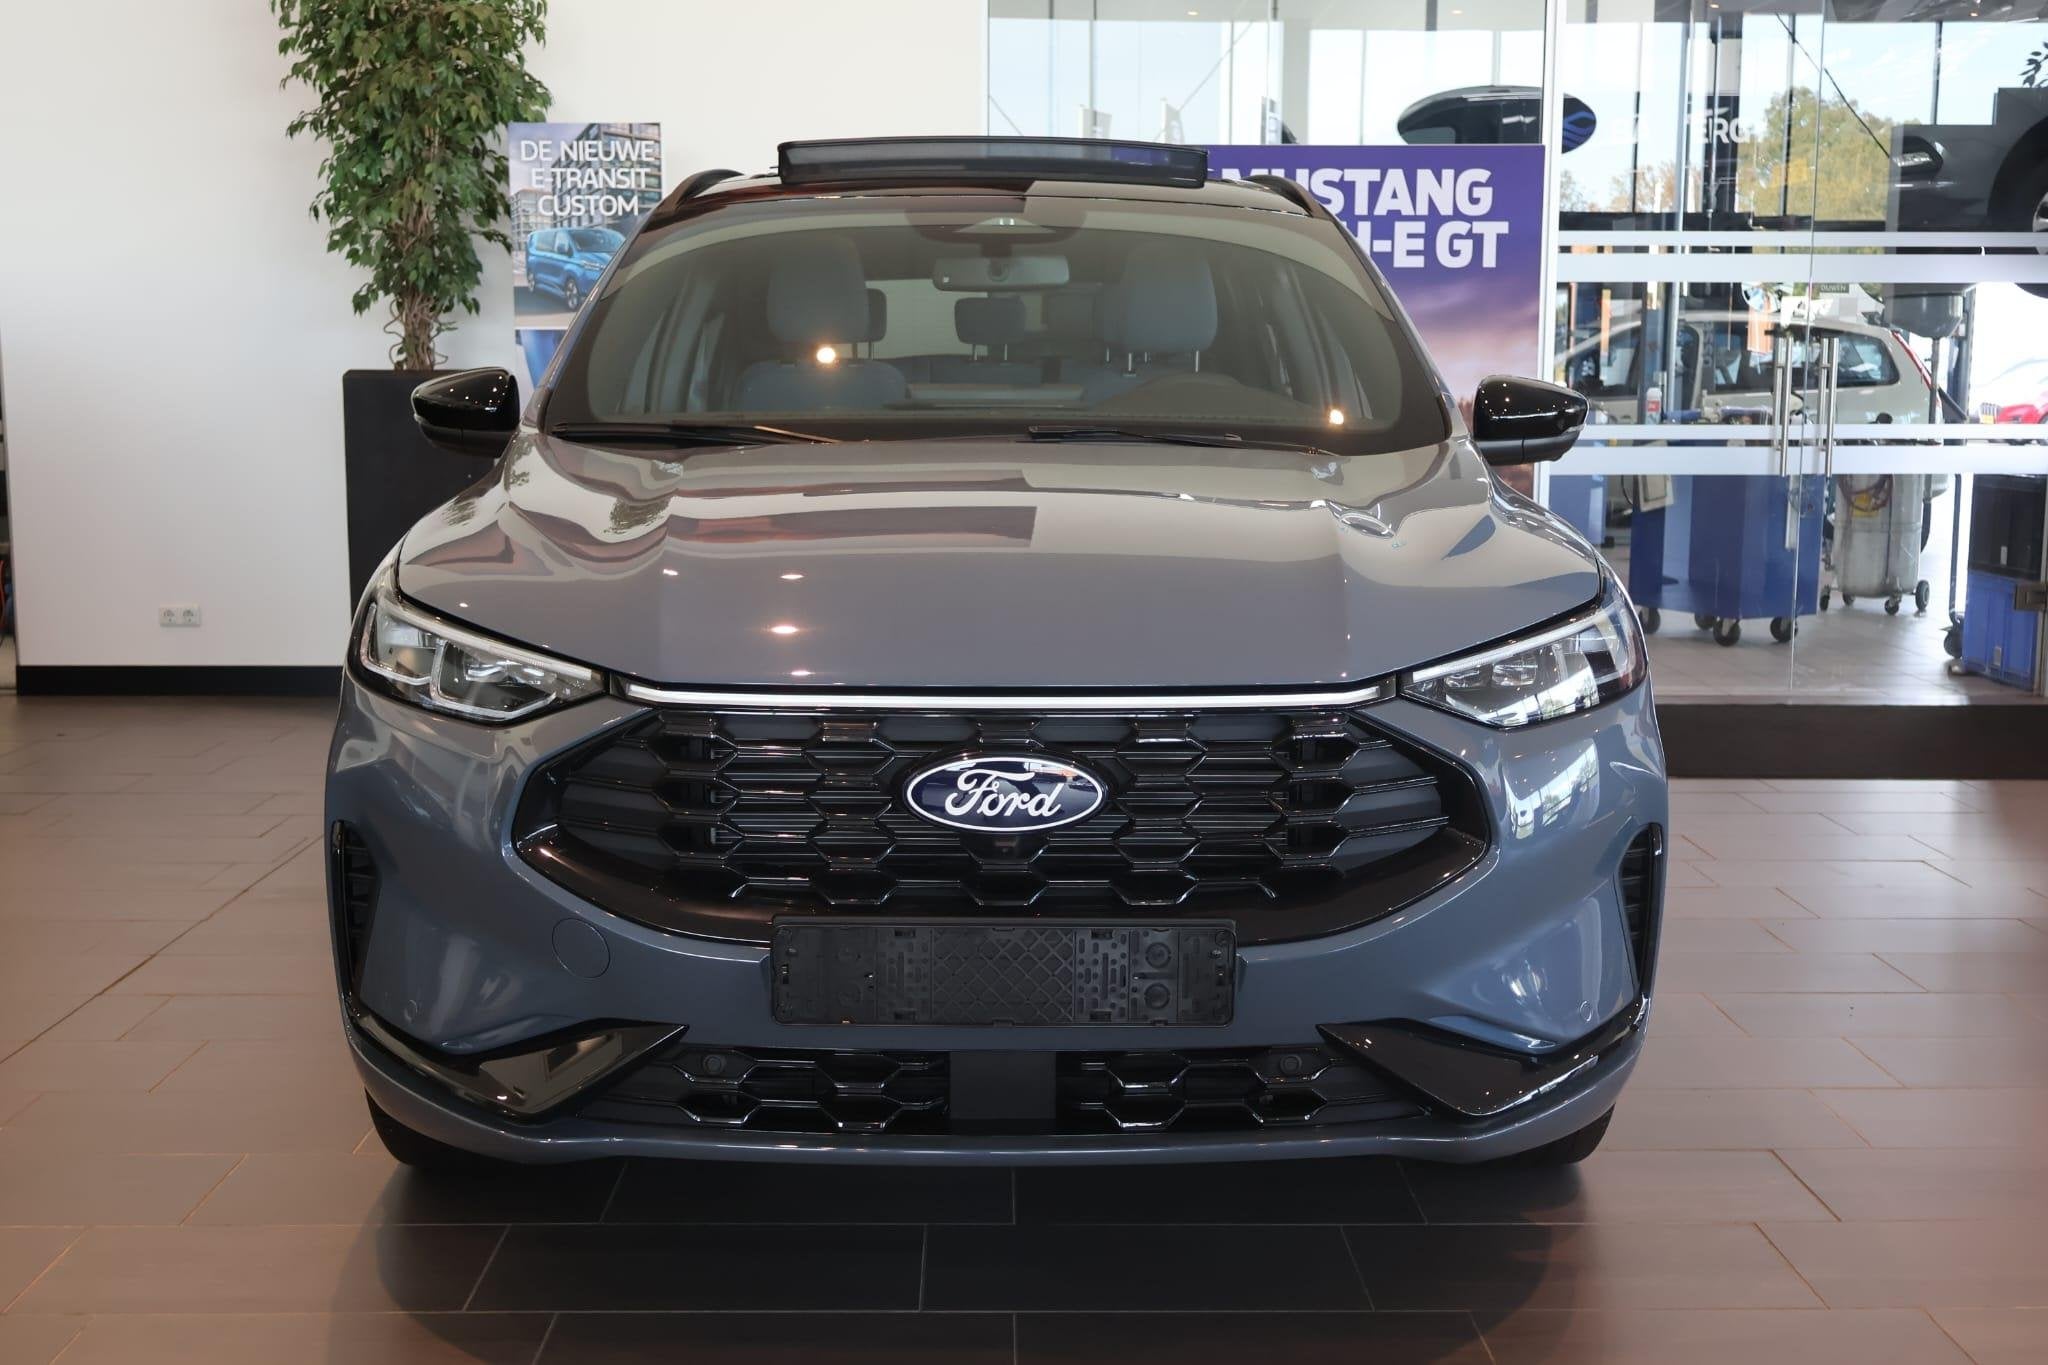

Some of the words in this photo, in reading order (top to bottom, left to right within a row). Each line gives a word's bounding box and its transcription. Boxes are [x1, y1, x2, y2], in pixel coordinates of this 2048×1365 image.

[522, 141, 552, 160] DE
[560, 141, 654, 160] NIEUWE
[531, 168, 650, 188] E-TRANSIT
[1222, 168, 1493, 216] STANG
[539, 196, 638, 216] CUSTOM
[1436, 220, 1509, 269] GT
[945, 769, 1062, 816] Ford
